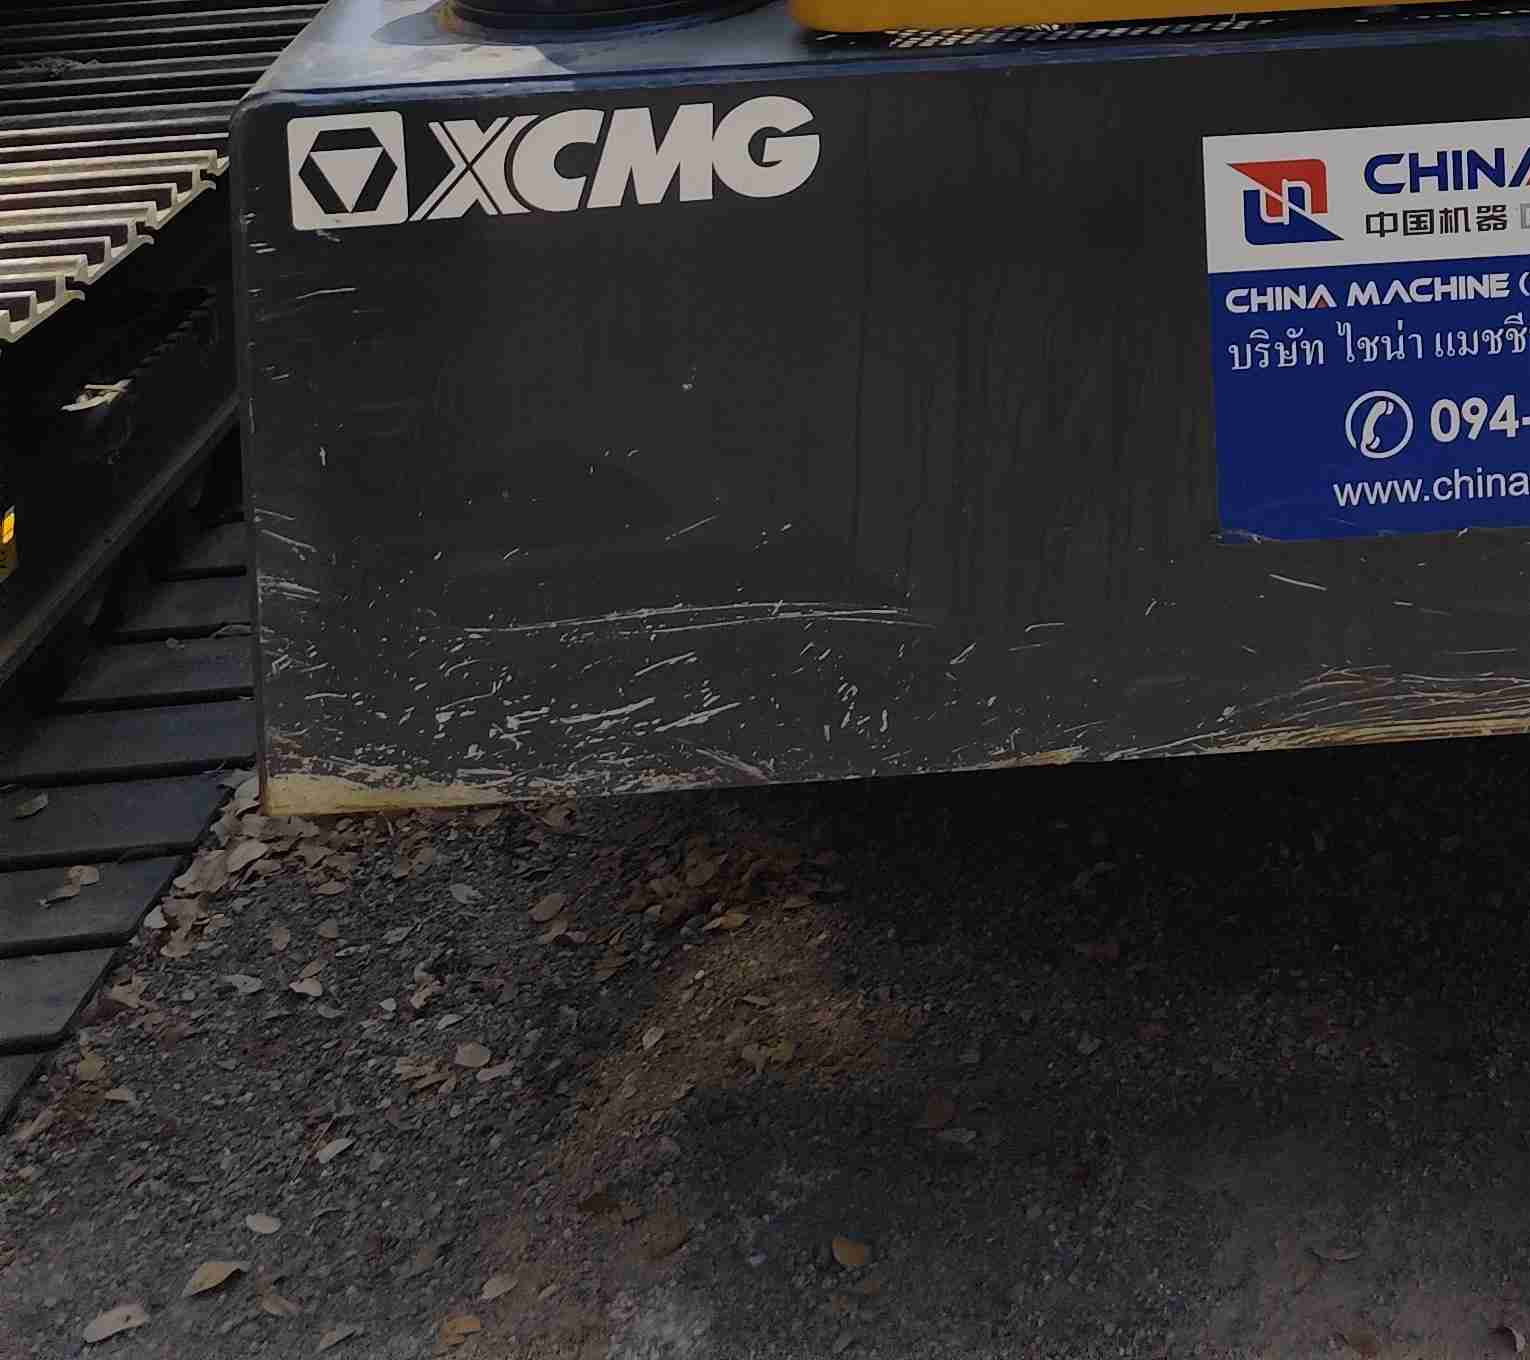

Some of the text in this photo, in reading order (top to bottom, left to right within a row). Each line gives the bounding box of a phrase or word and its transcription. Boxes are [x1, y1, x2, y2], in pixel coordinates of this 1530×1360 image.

[407, 95, 821, 223] XCMG
[1365, 204, 1508, 238] 中国机器
[1224, 284, 1338, 314] CHINA
[1346, 273, 1511, 308] MACHINE
[1227, 326, 1325, 371] บริษัท
[1335, 319, 1424, 363] ไชน่า
